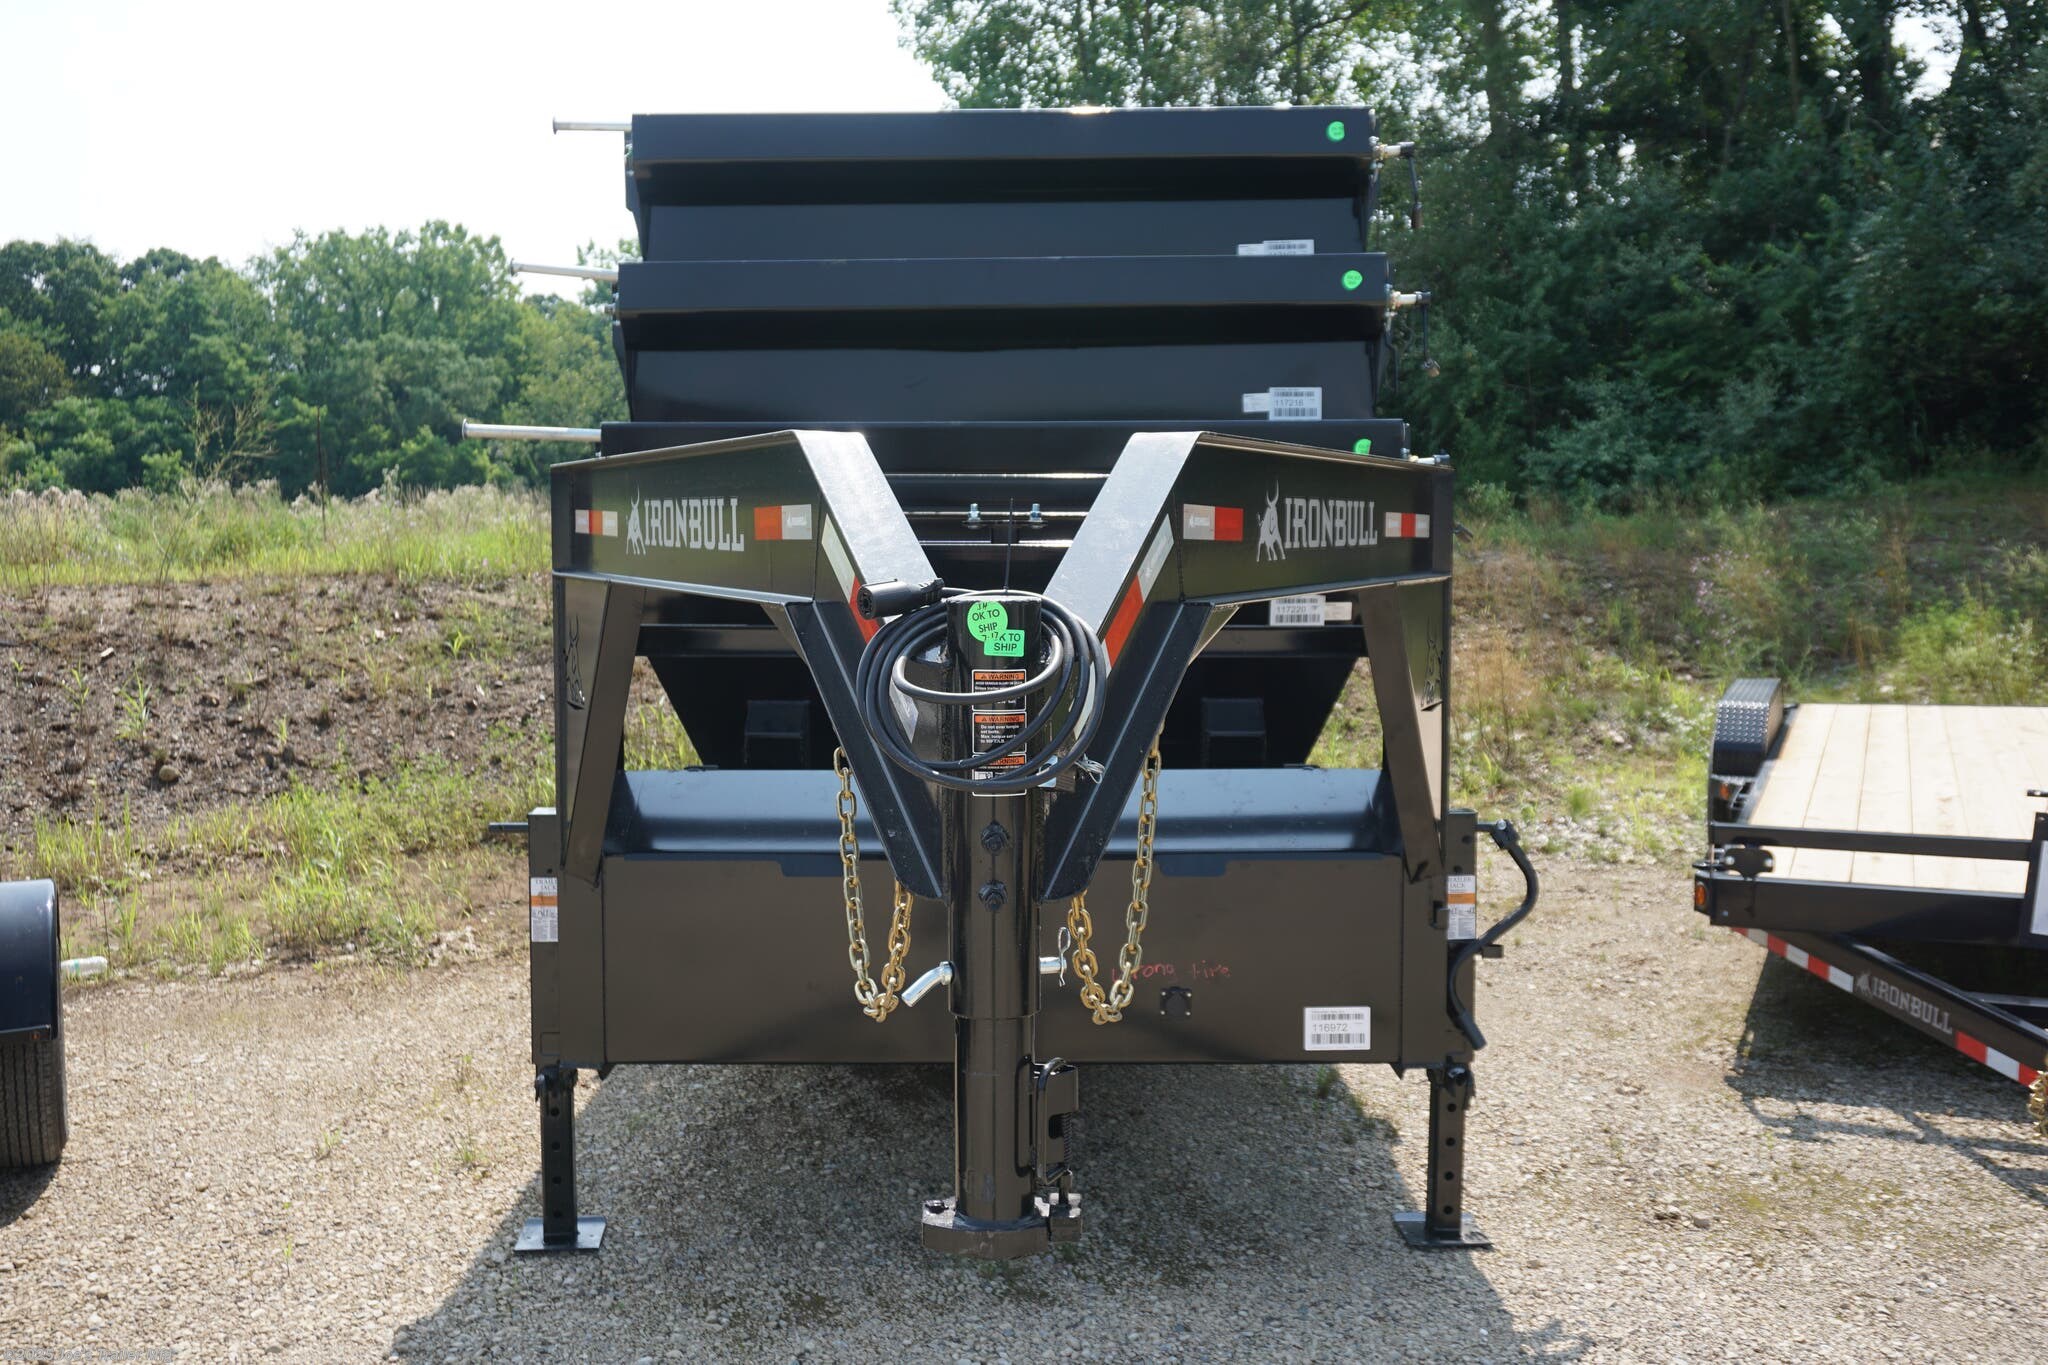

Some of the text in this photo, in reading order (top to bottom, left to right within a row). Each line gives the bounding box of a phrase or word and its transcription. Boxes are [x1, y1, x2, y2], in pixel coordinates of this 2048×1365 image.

[644, 498, 745, 552] IRONBULL
[1285, 498, 1378, 549] IRONBULL
[972, 609, 1000, 621] OK TO
[978, 622, 998, 633] SHIP
[1008, 633, 1021, 642] TO
[993, 643, 1018, 651] SHIP
[1872, 976, 1953, 1034] IRONBULL
[1312, 1023, 1349, 1032] 116972
